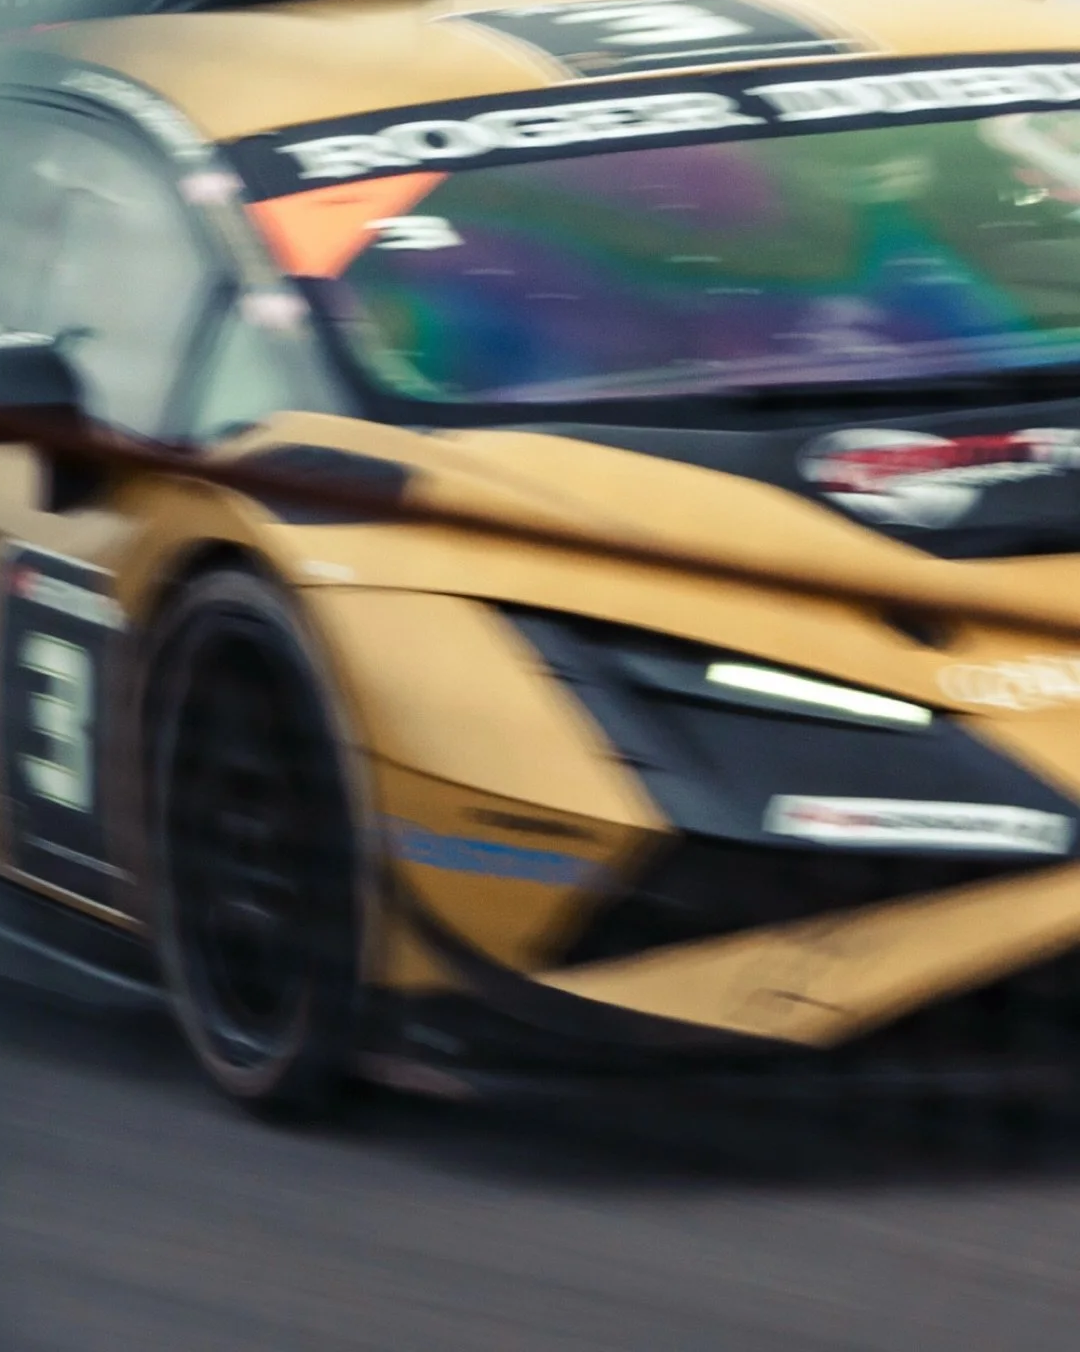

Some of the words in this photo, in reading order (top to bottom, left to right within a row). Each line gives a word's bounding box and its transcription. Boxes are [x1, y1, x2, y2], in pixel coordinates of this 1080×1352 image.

[273, 91, 768, 181] ROGER
[366, 214, 464, 251] 3
[17, 628, 95, 815] 3
